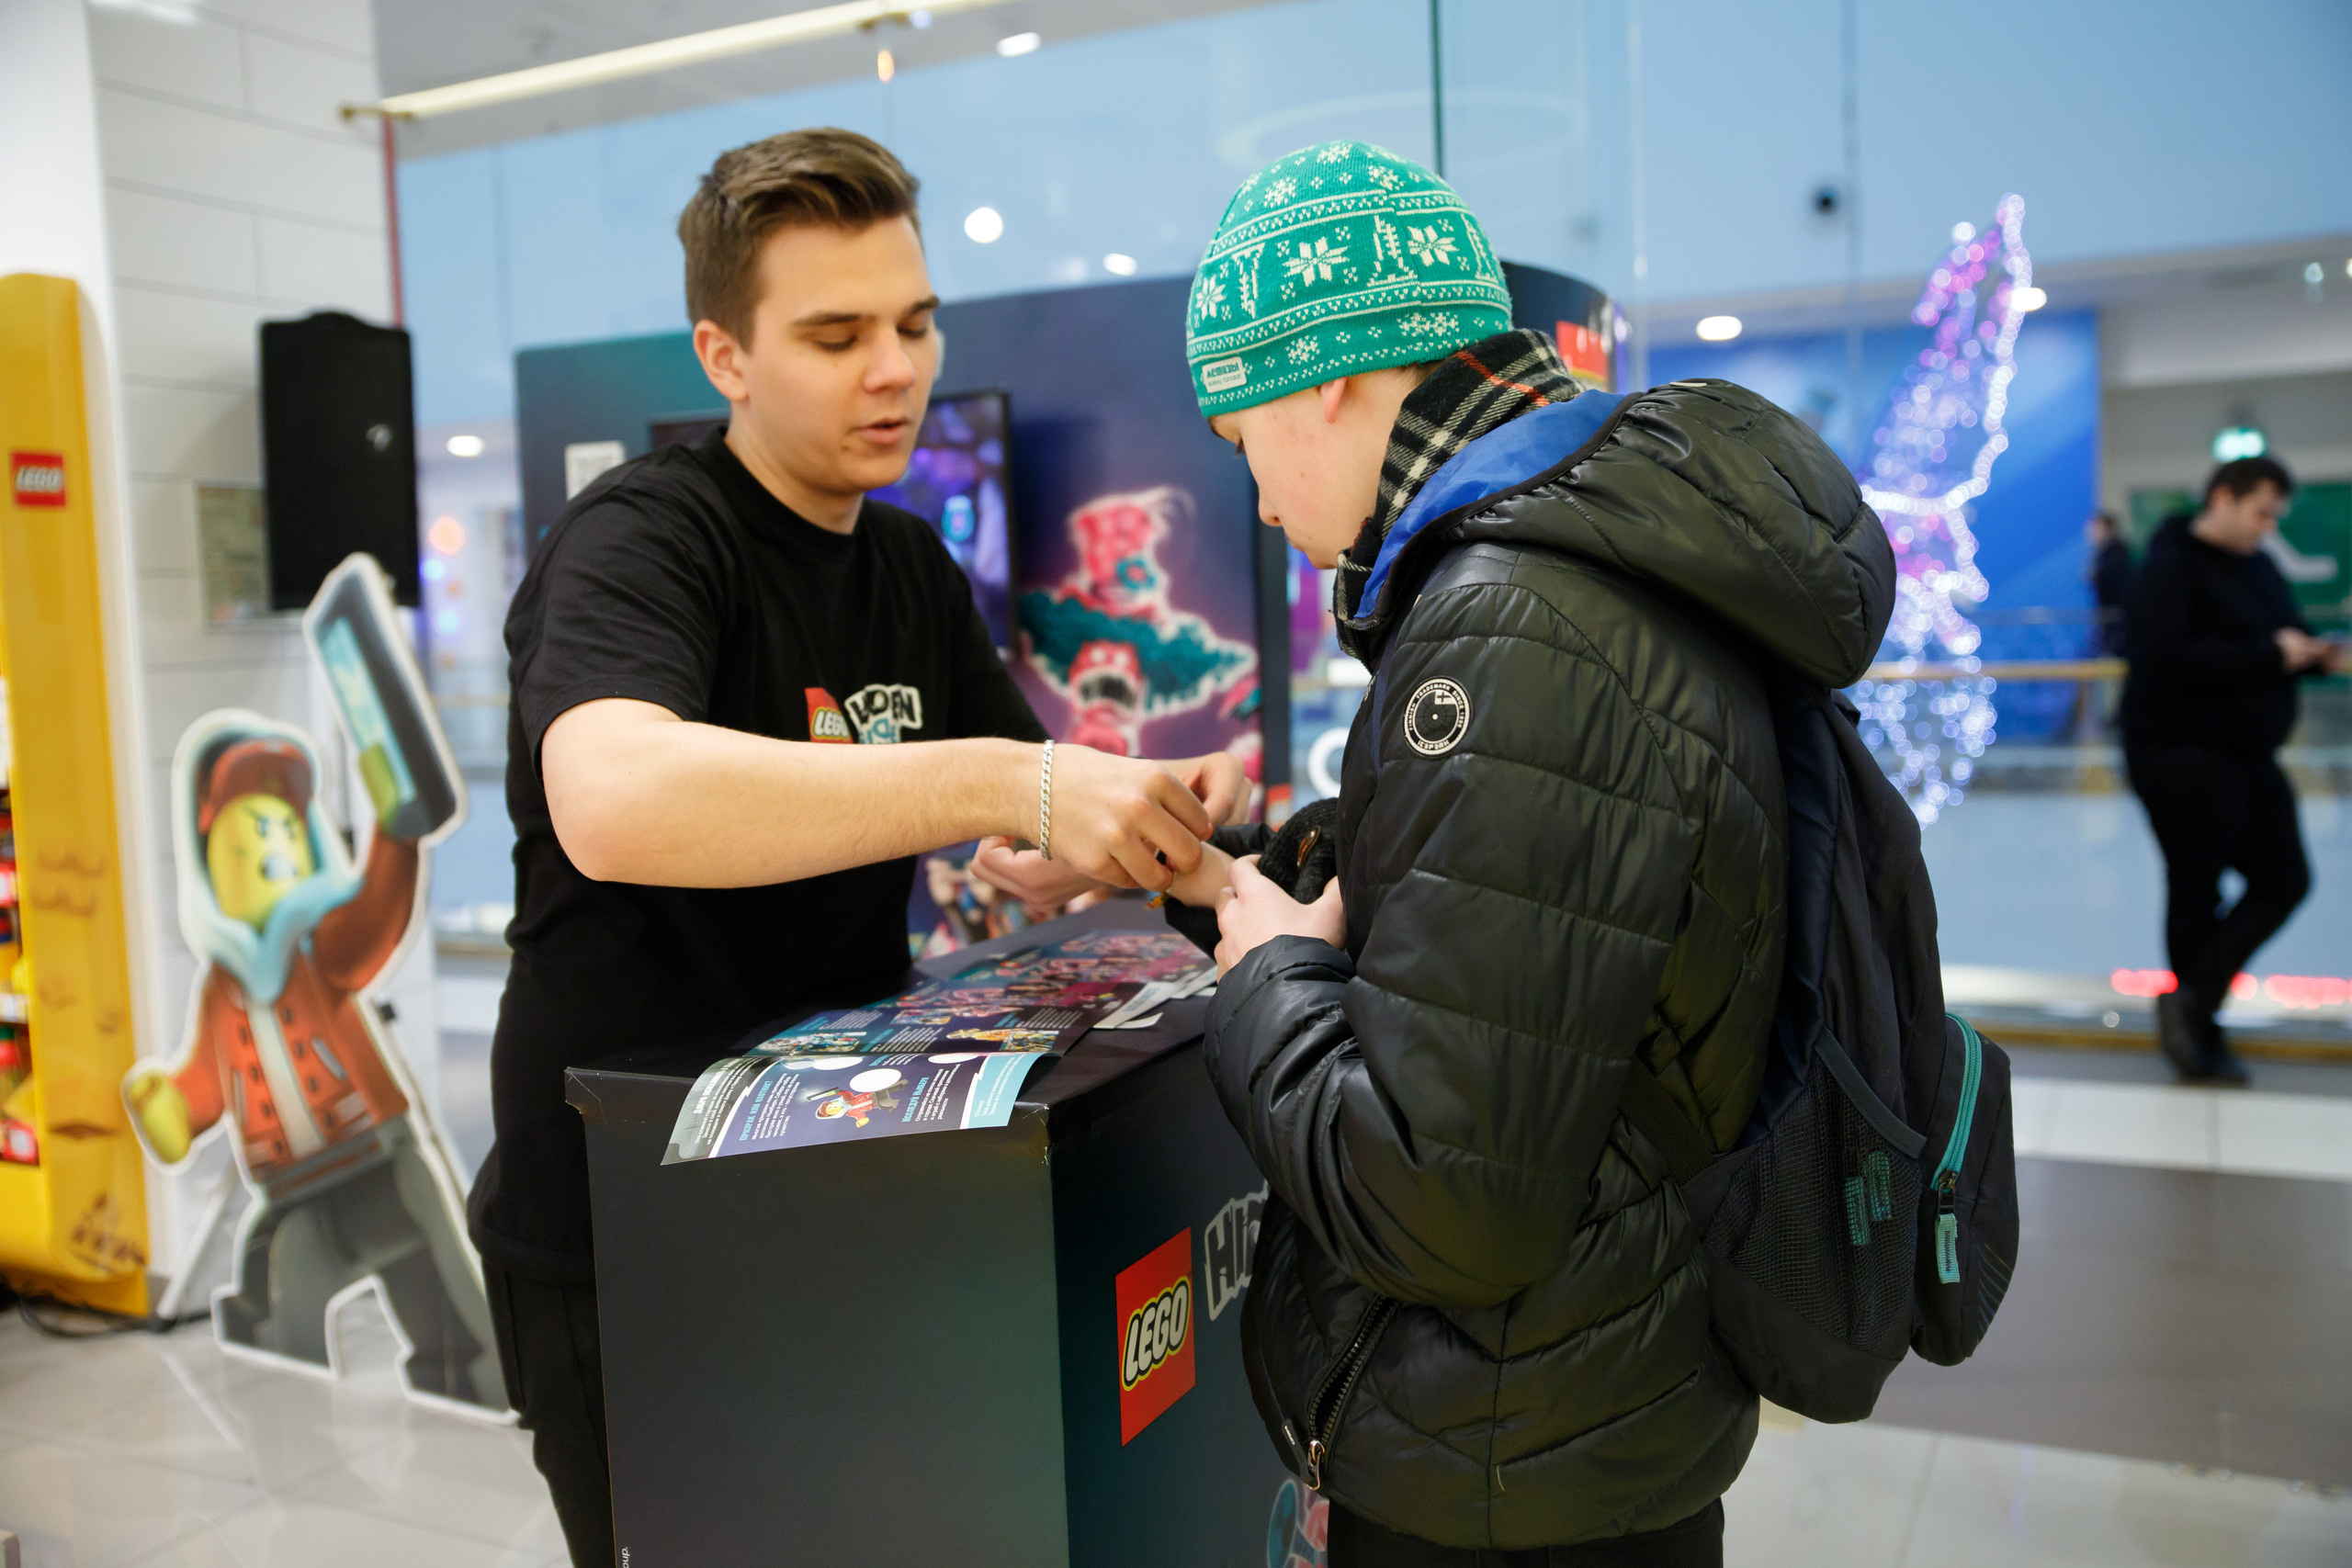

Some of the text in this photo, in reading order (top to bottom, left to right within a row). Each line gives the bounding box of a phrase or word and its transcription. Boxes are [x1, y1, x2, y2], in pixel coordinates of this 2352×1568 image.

[15, 465, 64, 493] LEGO
[1416, 683, 1451, 699] TRADEMARK
[1452, 690, 1464, 709] SINCE
[1417, 740, 1450, 750] ICEPEAK
[739, 1081, 773, 1141] ПРИЗРАК ИЛИ ОХОТНИК?
[902, 1077, 929, 1122] ИССЛЕДУЙ НЬЮБЕРИ
[1205, 1196, 1264, 1315] HI
[1123, 1277, 1191, 1389] LEGO
